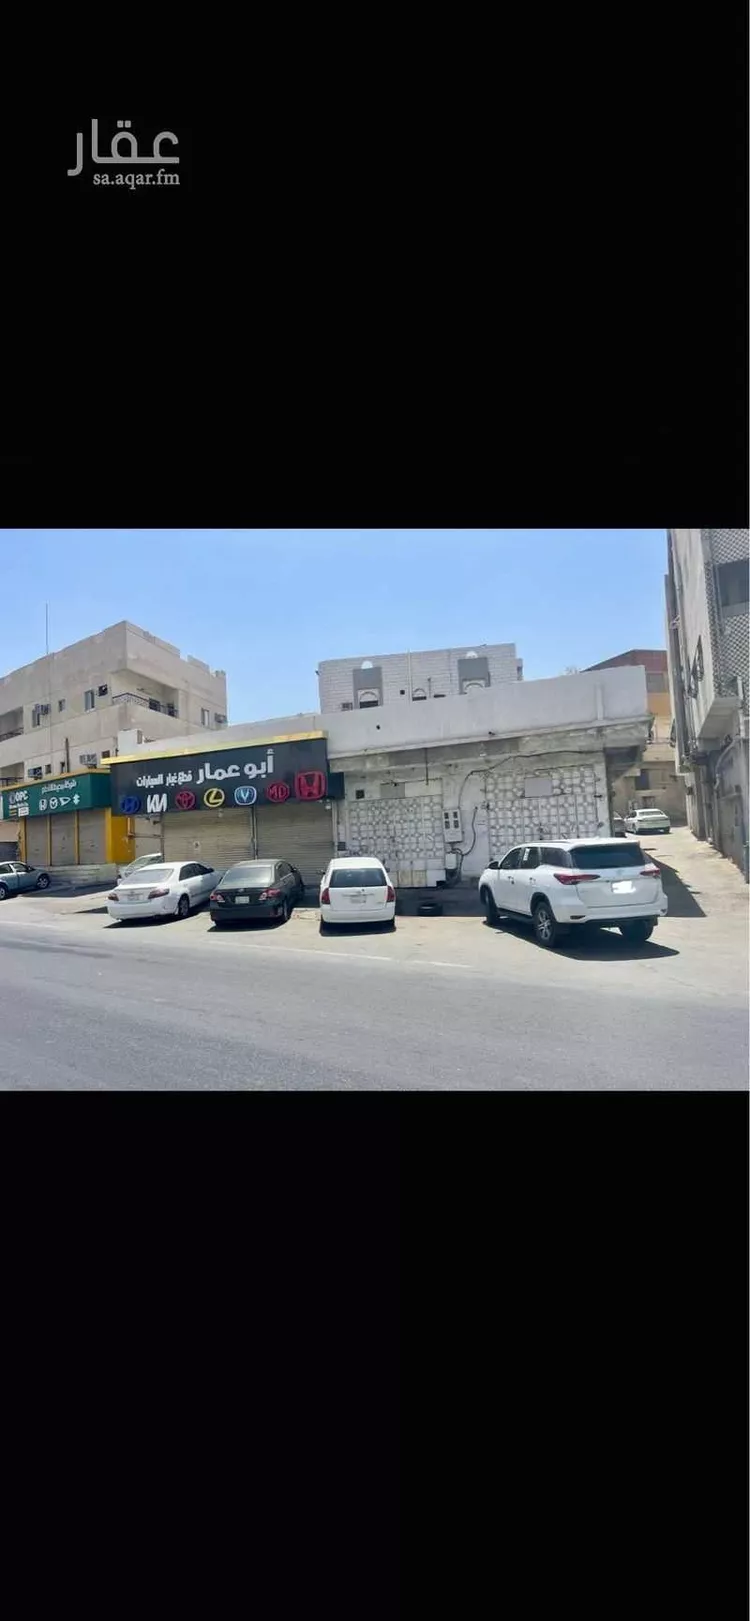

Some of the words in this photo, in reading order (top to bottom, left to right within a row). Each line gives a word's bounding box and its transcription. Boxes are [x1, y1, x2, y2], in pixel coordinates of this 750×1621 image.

[196, 762, 241, 784] عمار
[243, 748, 274, 779] أبو
[136, 773, 164, 789] السيارات
[165, 772, 178, 787] غيار
